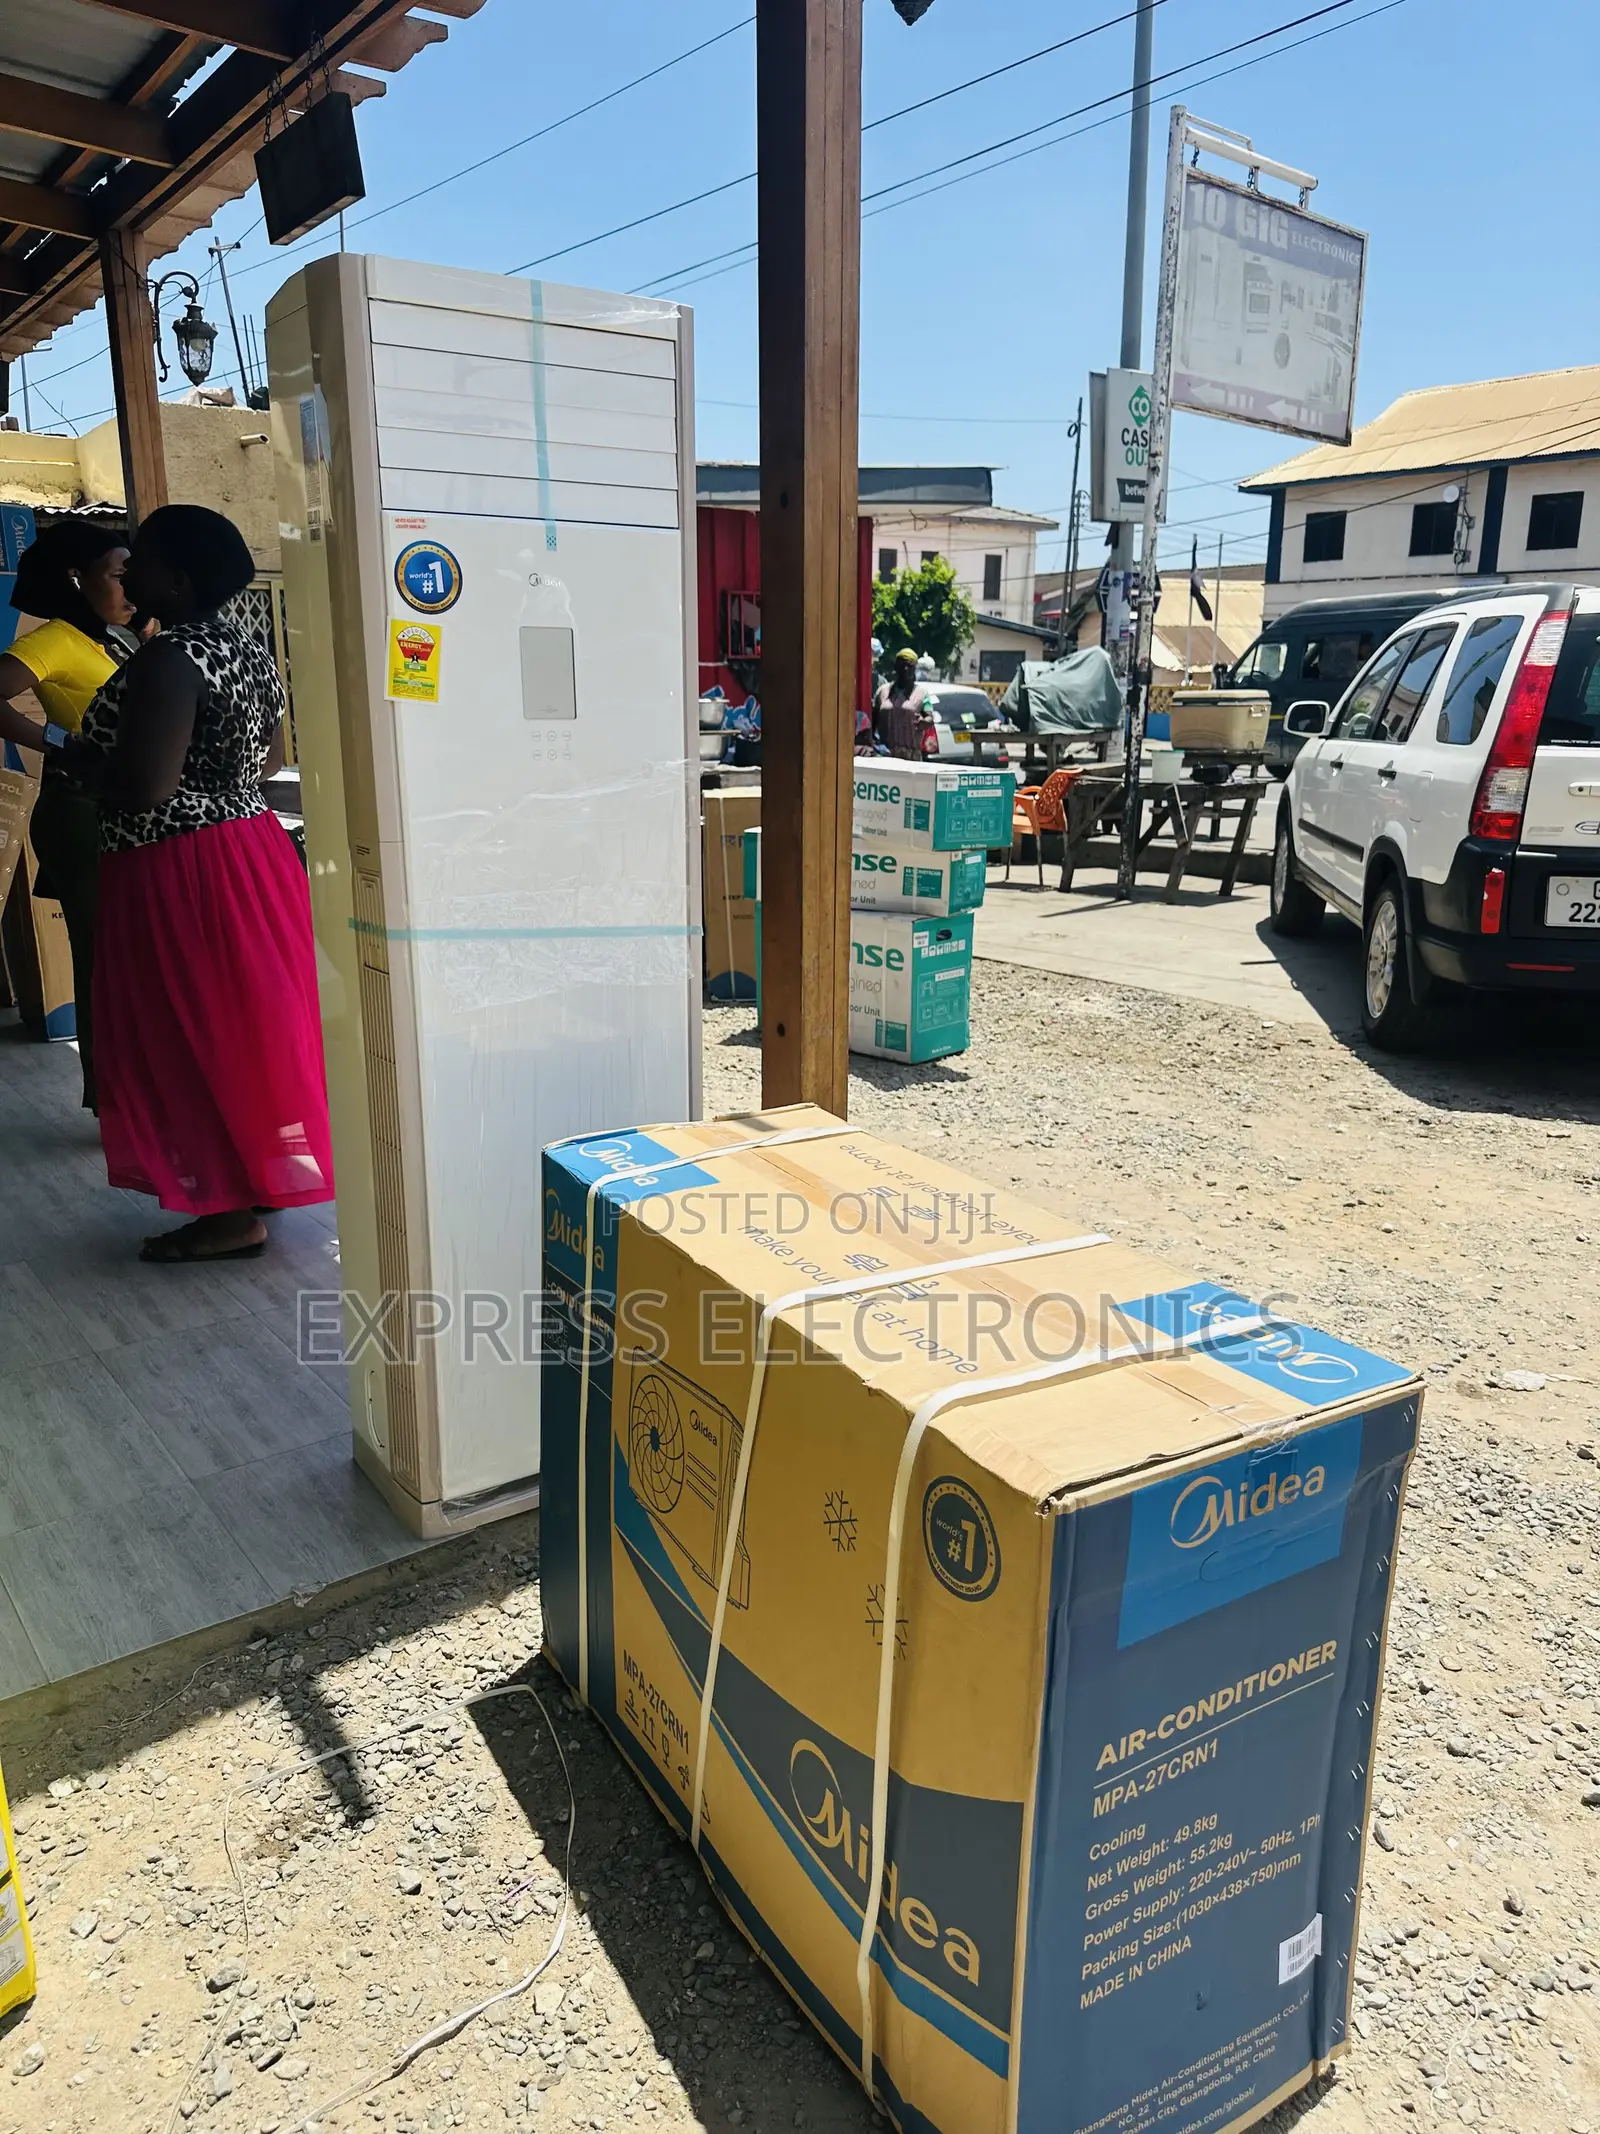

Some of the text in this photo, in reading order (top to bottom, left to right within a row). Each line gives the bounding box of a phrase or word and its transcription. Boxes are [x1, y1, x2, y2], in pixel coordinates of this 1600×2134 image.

[1190, 183, 1227, 229] 10
[1292, 232, 1361, 267] ELECTRONICS
[1121, 428, 1148, 447] CAS
[1125, 448, 1148, 466] OU
[11, 514, 28, 561] Mide
[853, 780, 901, 805] ense
[860, 896, 876, 904] Unit
[1568, 902, 1600, 923] 22
[864, 1005, 881, 1017] Unit
[579, 1139, 660, 1187] Mida
[545, 1189, 605, 1272] Mida
[991, 1218, 1041, 1246] ake
[737, 1224, 978, 1374] make yourelf at home
[689, 1409, 718, 1446] Midea
[935, 1517, 963, 1541] world's
[1170, 1465, 1326, 1549] Midea
[623, 1648, 690, 1755] MPA-27CRN1
[1095, 1639, 1338, 1772] AIR-CONDITIONER
[1093, 1738, 1219, 1819] MPA-27CRN1
[1087, 1812, 1219, 1892] Net Weight: 49.8kg
[1089, 1821, 1147, 1862] Cooling
[1083, 1812, 1321, 1951] Power Supply: 220-240V~ 50Hz, 1Ph
[1085, 1832, 1233, 1921] Gross Weight: 55.2kg
[1080, 1934, 1193, 2010] MADE IN CHINA
[1081, 1939, 1139, 1981] Packing
[1073, 2103, 1129, 2134] Guangdong
[1131, 2085, 1159, 2107] Midea
[1161, 2042, 1235, 2089] Air-Conditioning
[1236, 2012, 1281, 2046] Equipment
[1137, 2104, 1150, 2117] 22
[1196, 2063, 1222, 2083] Road,
[1179, 2072, 1234, 2106] Guangdong,
[1252, 2045, 1276, 2064] China
